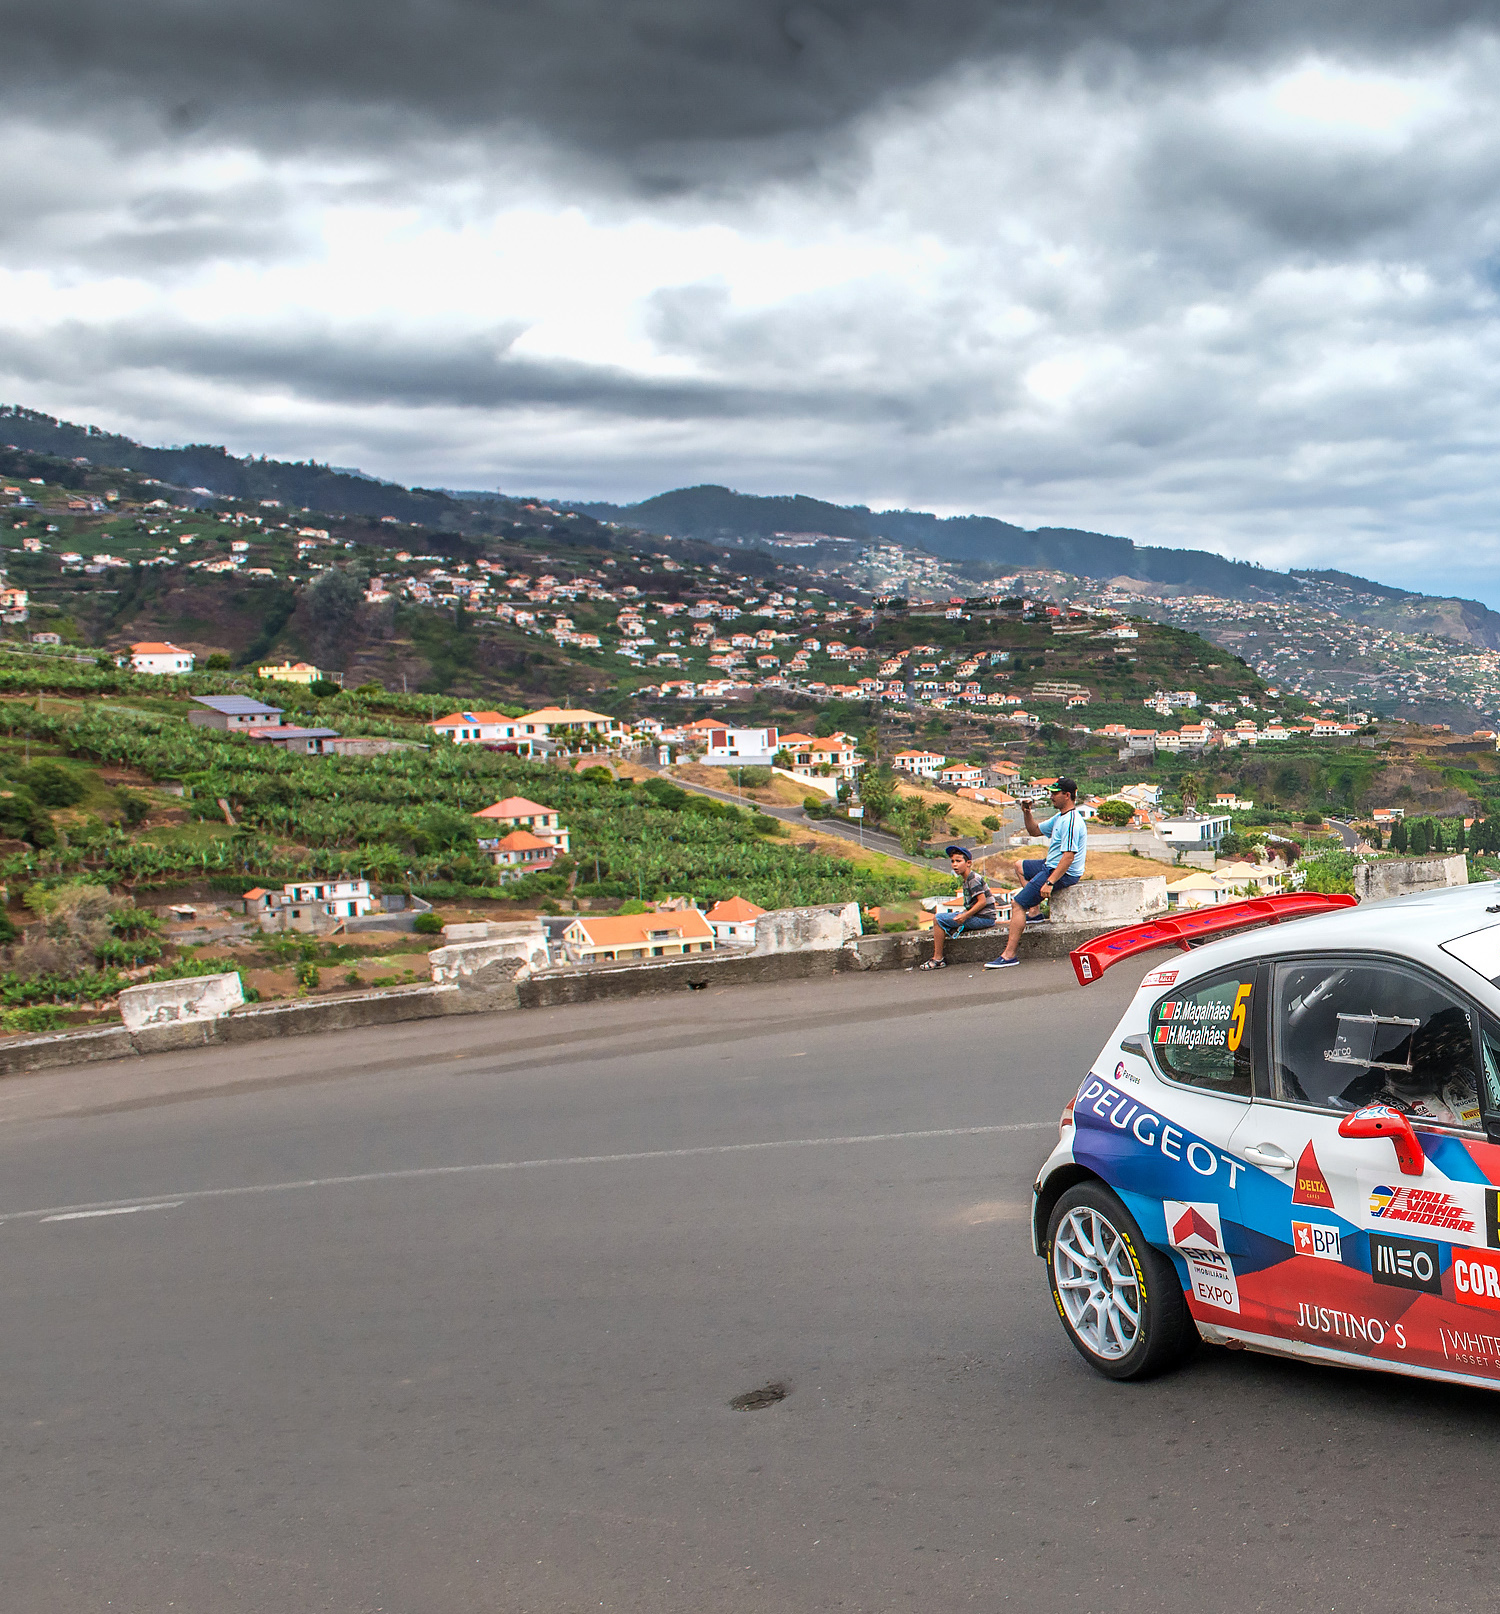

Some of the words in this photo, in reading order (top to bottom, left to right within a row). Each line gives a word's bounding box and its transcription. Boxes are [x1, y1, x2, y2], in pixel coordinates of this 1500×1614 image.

[1173, 1001, 1231, 1025] B.Magalhães
[1228, 984, 1252, 1051] 5
[1168, 1025, 1225, 1050] H.Magalhães
[1324, 1047, 1351, 1058] sparco
[1078, 1081, 1246, 1189] PEUGEOT
[1299, 1179, 1326, 1193] DELTA
[1405, 1199, 1467, 1218] VINHO
[1390, 1208, 1476, 1234] MADEIRA
[1313, 1230, 1340, 1255] BPI
[1180, 1247, 1225, 1265] ERA
[1378, 1244, 1434, 1282] MEO
[1198, 1282, 1233, 1305] EXPO
[1455, 1353, 1488, 1366] ASSET
